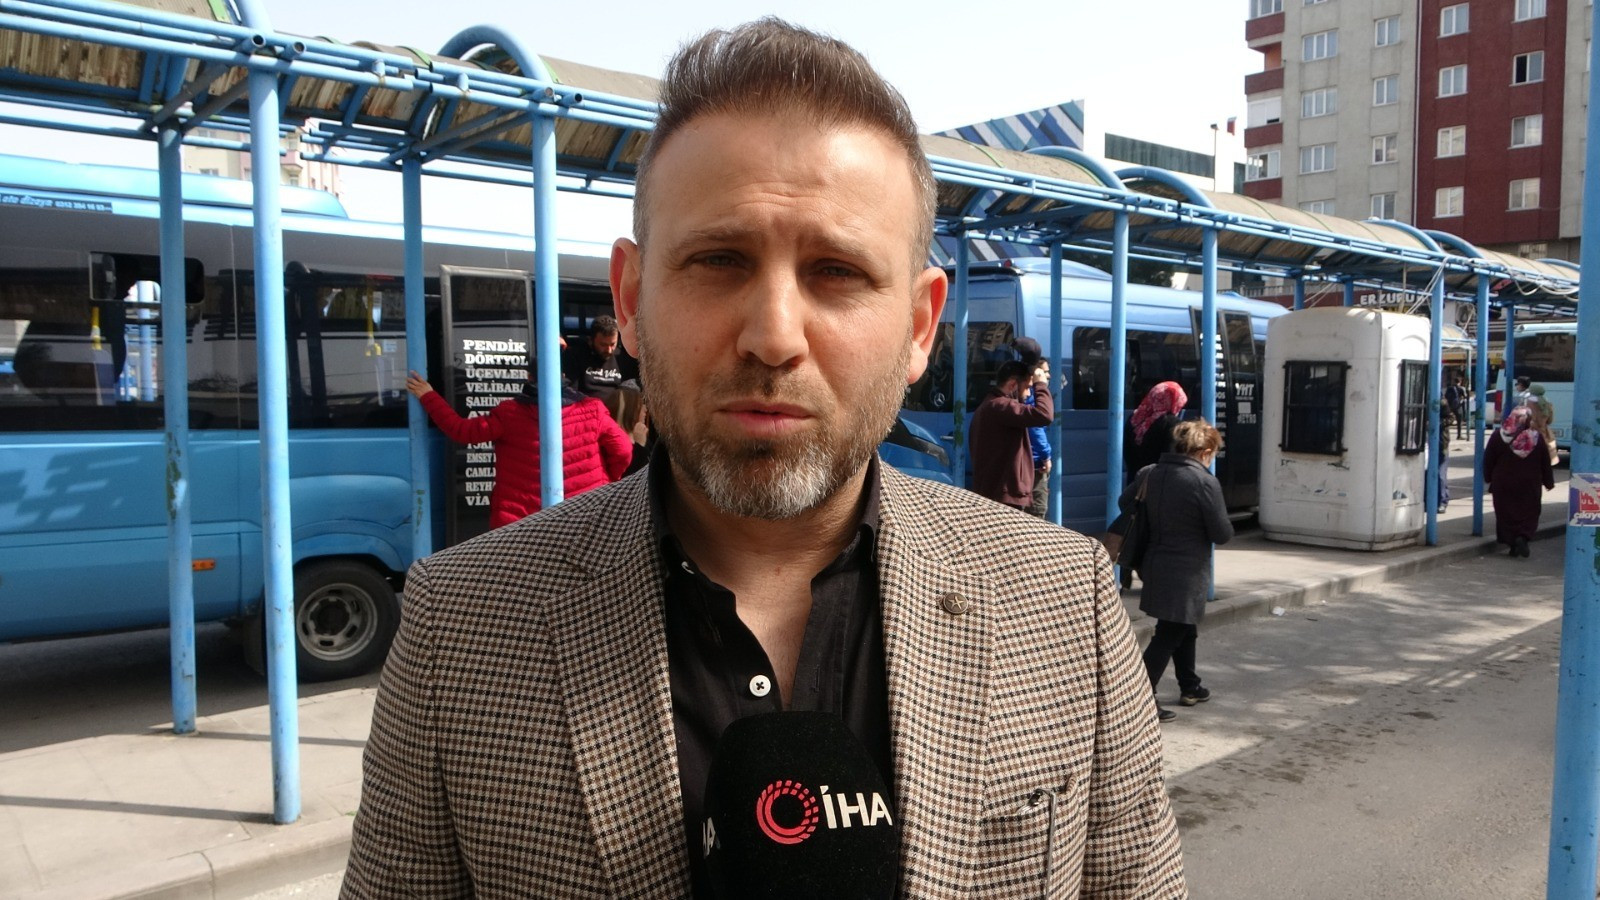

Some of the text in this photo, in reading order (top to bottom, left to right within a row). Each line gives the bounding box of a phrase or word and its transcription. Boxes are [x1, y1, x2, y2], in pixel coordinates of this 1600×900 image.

[463, 339, 527, 353] PENDİK
[464, 351, 529, 366] DÖRTYOL
[465, 365, 529, 381] ÜÇEVLER
[820, 785, 893, 829] İHA
